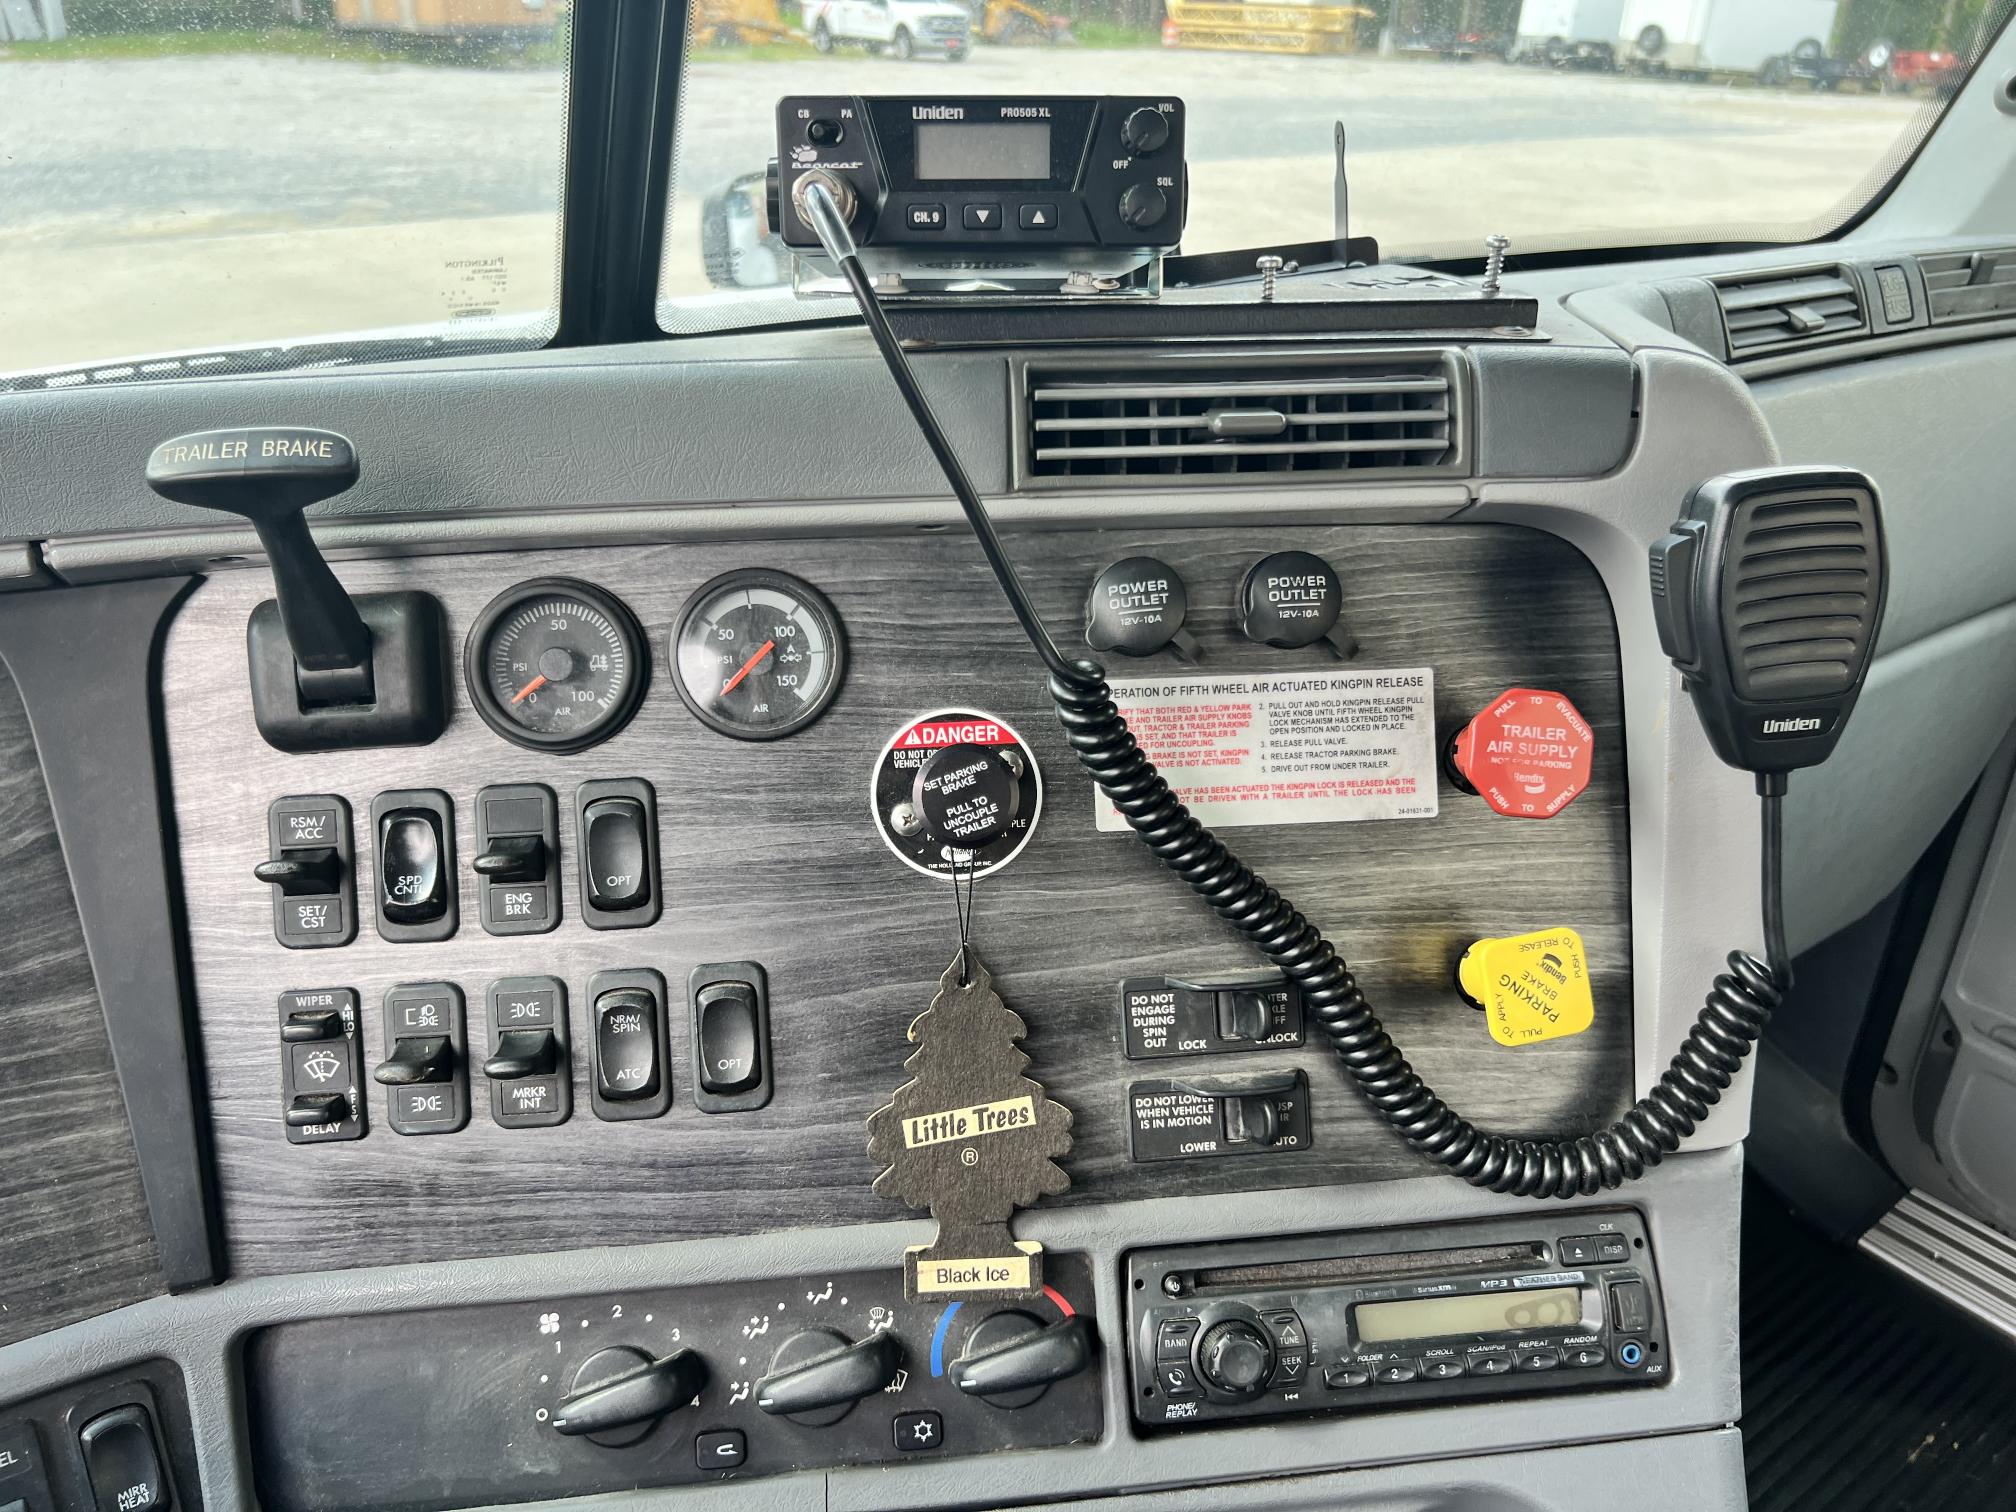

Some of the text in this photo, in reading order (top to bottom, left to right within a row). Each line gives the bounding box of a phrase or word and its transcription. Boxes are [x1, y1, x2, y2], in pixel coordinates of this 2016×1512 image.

[798, 108, 810, 119] CB
[840, 108, 853, 119] PA
[912, 106, 964, 121] Uniden
[1158, 103, 1175, 113] VOL
[1112, 160, 1128, 169] OFF
[1156, 177, 1174, 186] SQL
[932, 212, 940, 224] 9
[163, 440, 334, 465] TRAILER BRAKE
[1267, 575, 1326, 589] POWER
[1108, 580, 1168, 598] POWER
[1268, 588, 1327, 602] OUTLET
[1108, 593, 1169, 610] OUTLET
[1278, 609, 1320, 619] 12V-10A
[550, 619, 568, 631] 50
[1120, 614, 1162, 627] 12V-10A
[717, 628, 735, 641] 50
[774, 626, 796, 637] 100
[716, 655, 733, 664] PSI
[512, 662, 528, 672] PSI
[776, 675, 798, 687] 150
[1108, 676, 1424, 699] PERATION OF FIFTH WHEEL AIR ACTUATED KINGPIN RELEASE
[529, 692, 537, 704] 0
[571, 690, 595, 702] 100
[752, 704, 769, 713] AIR
[1268, 702, 1286, 710] PULL
[1288, 701, 1303, 709] OUT
[1304, 700, 1320, 708] AND
[1342, 698, 1371, 706] KINGPIN
[1372, 698, 1404, 706] RELEASE
[1406, 696, 1424, 704] PULL
[554, 707, 572, 716] AIR
[1269, 705, 1413, 718] VALVE KNOB UNTIL FIFTH WHEEL KINGPIN
[1493, 696, 1592, 743] PULL TO EVACUATE
[1762, 718, 1821, 734] Uniden
[922, 725, 999, 744] DANGER
[1501, 724, 1567, 741] TRAILER
[893, 750, 906, 760] DO
[908, 750, 925, 759] NOT
[1486, 740, 1579, 759] AIR SUPPLY
[1532, 760, 1572, 770] PARKING
[923, 760, 989, 791] SET PARKING
[941, 774, 977, 795] BRAKE
[1489, 784, 1577, 812] PUSH TO SUPPLY
[946, 796, 988, 817] PULL TO
[290, 815, 326, 828] RSM/
[943, 803, 999, 830] UNCOUPLE
[295, 827, 324, 839] ACC
[952, 816, 997, 838] TRAILER
[398, 875, 423, 886] SPD
[606, 875, 632, 886] OPT
[505, 892, 533, 904] ENG
[298, 905, 328, 918] SET/
[506, 904, 531, 915] BRK
[301, 917, 326, 929] CST
[1518, 936, 1582, 979] PUSH TO RELEASE
[1538, 960, 1568, 985] Bendix
[1520, 970, 1558, 1001] BRAKE
[296, 994, 334, 1007] WIPER
[1131, 993, 1175, 1006] DO NOT
[1498, 974, 1561, 1023] PARKING
[342, 1010, 354, 1021] HI
[1130, 1004, 1176, 1016] ENGAGE
[610, 1013, 641, 1025] NRM/
[1133, 1015, 1176, 1028] DURING
[1495, 994, 1543, 1039] PULL TO APPLY
[343, 1022, 355, 1032] LO
[612, 1022, 641, 1034] SPIN
[1142, 1026, 1167, 1038] SPIN
[1144, 1037, 1167, 1048] OUT
[1255, 1032, 1298, 1045] LOCK
[1178, 1040, 1207, 1050] LOCK
[718, 1058, 742, 1070] OPT
[616, 1068, 641, 1080] ATC
[512, 1086, 546, 1099] MRKR
[520, 1097, 542, 1109] INT
[1135, 1094, 1215, 1108] DO NOT LOWER
[351, 1105, 356, 1115] S
[1136, 1104, 1214, 1118] WHEN VEHICLE
[302, 1122, 341, 1136] DELAY
[911, 1106, 1030, 1145] Little Trees
[1140, 1116, 1212, 1130] IS IN MOTION
[1273, 1136, 1297, 1146] UTO
[1180, 1142, 1217, 1153] LOWER
[1604, 1244, 1623, 1254] DISP
[936, 1266, 1010, 1284] Black Ice
[1480, 1279, 1508, 1288] MP3
[612, 1304, 623, 1318] 2
[672, 1328, 681, 1342] 3
[1280, 1336, 1300, 1345] TUNE
[1564, 1335, 1598, 1344] RANDOM
[555, 1340, 562, 1353] 1
[1164, 1338, 1187, 1348] BAND
[1518, 1340, 1549, 1348] REPEAT
[1356, 1353, 1383, 1362] FOLDER
[1426, 1348, 1454, 1357] SCROLL
[1580, 1352, 1587, 1363] 6
[1281, 1356, 1302, 1366] SEEK
[1486, 1360, 1494, 1371] 4
[1533, 1356, 1540, 1367] 5
[1391, 1368, 1398, 1379] 2
[1439, 1365, 1446, 1375] 3
[1646, 1365, 1662, 1373] AUX
[1343, 1373, 1349, 1383] 1
[690, 1394, 700, 1407] 4
[1166, 1402, 1196, 1412] PHONE/
[1165, 1408, 1198, 1419] REPLAY
[117, 1482, 149, 1503] MIRR
[118, 1490, 151, 1512] HEAT
